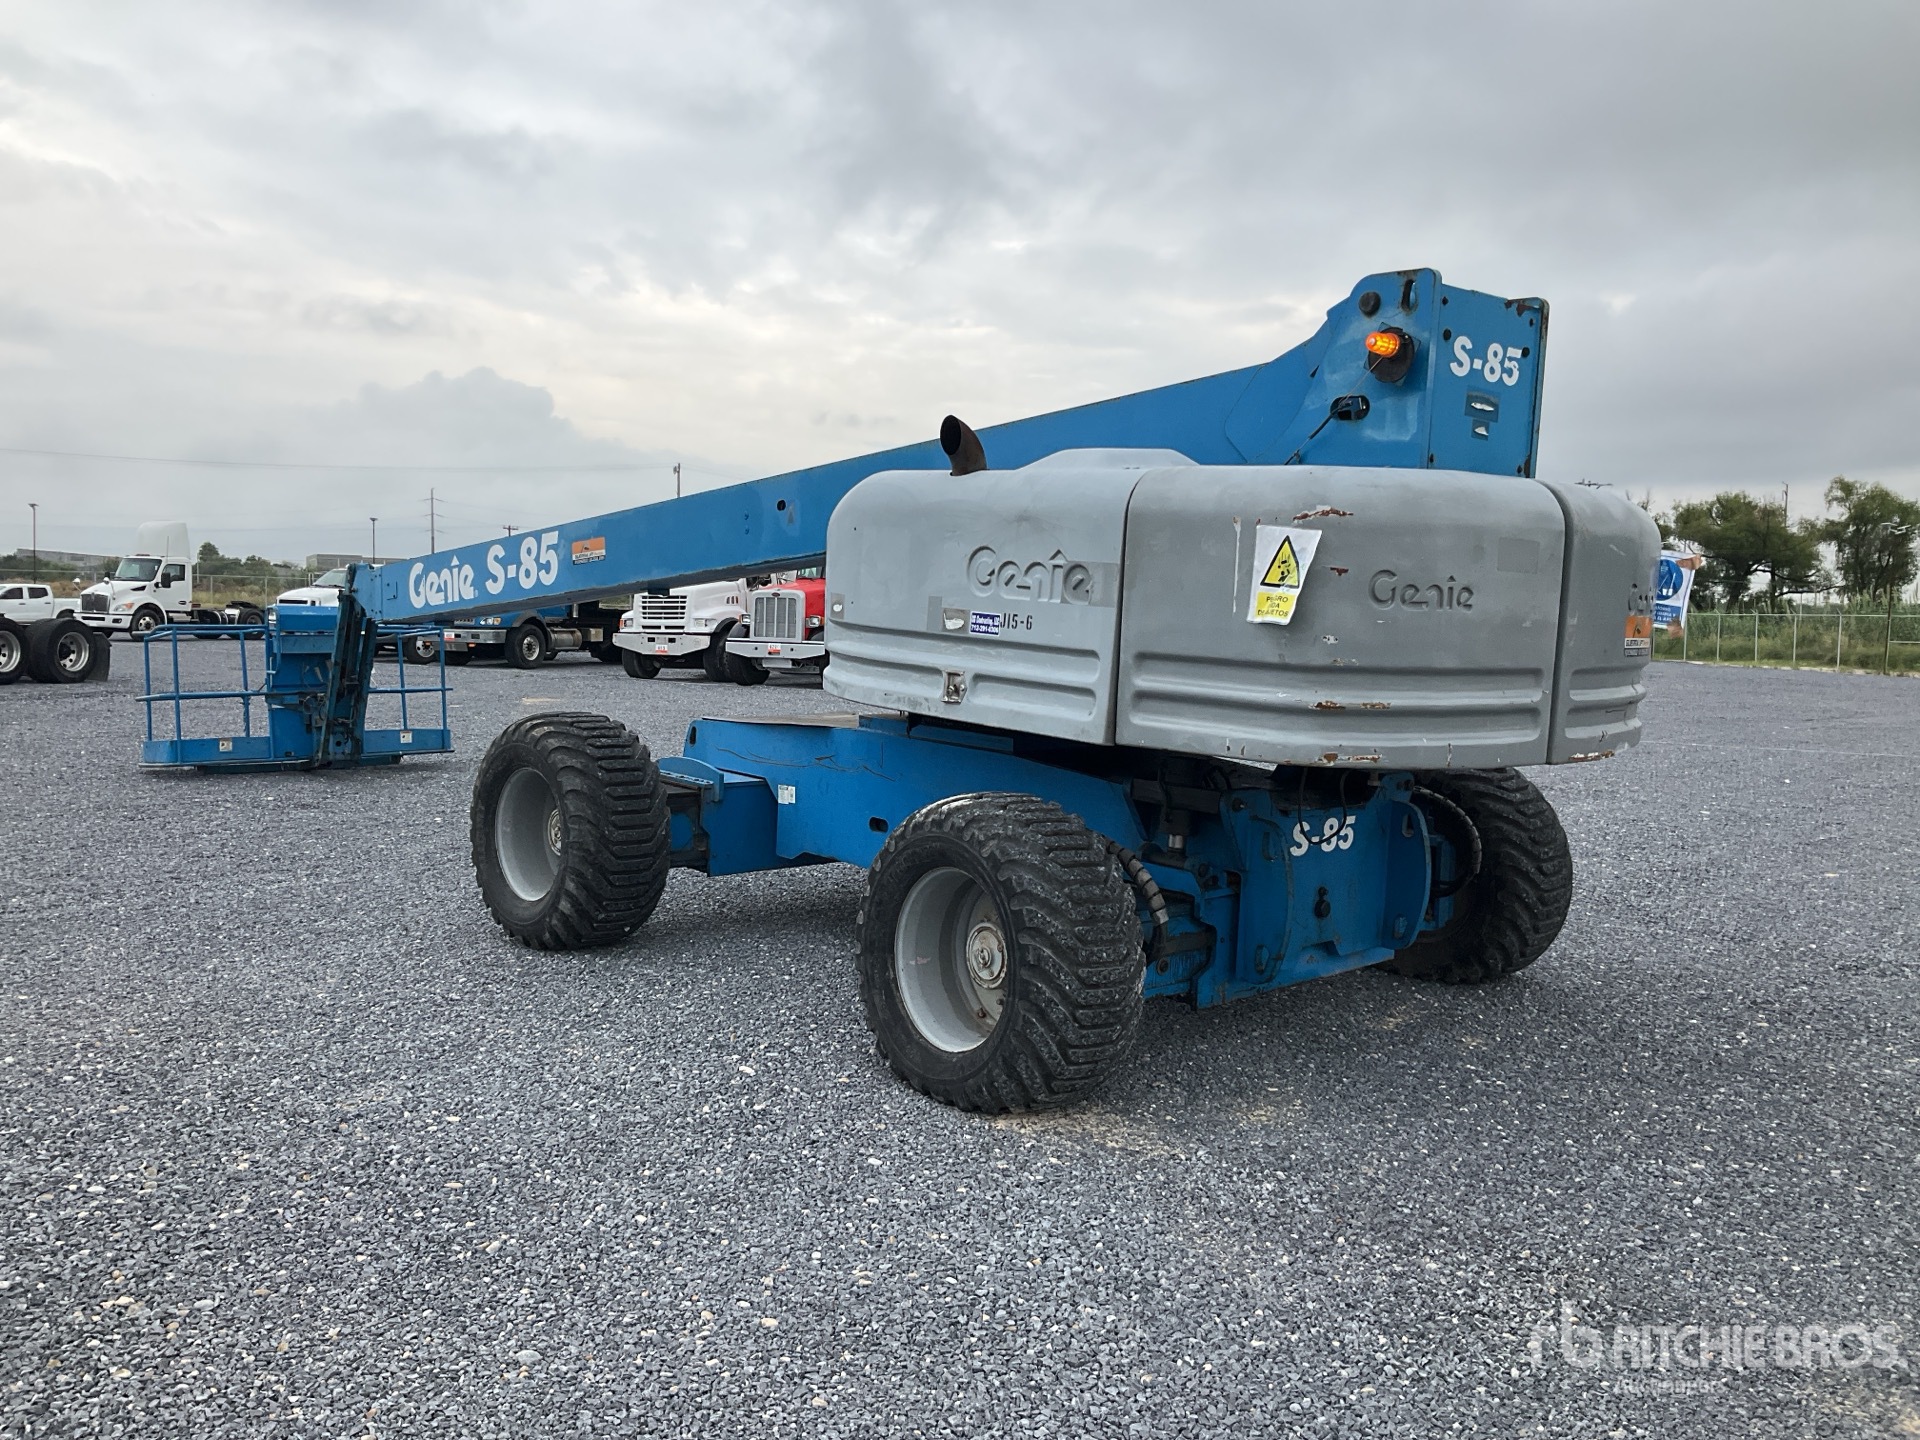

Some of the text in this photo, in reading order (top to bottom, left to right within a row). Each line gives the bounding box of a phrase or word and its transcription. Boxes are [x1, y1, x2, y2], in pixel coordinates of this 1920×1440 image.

[1449, 335, 1522, 387] S-85
[409, 530, 559, 609] Genie S-85
[967, 545, 1092, 605] Genie
[1368, 569, 1474, 613] Genie
[1289, 815, 1356, 857] S-85
